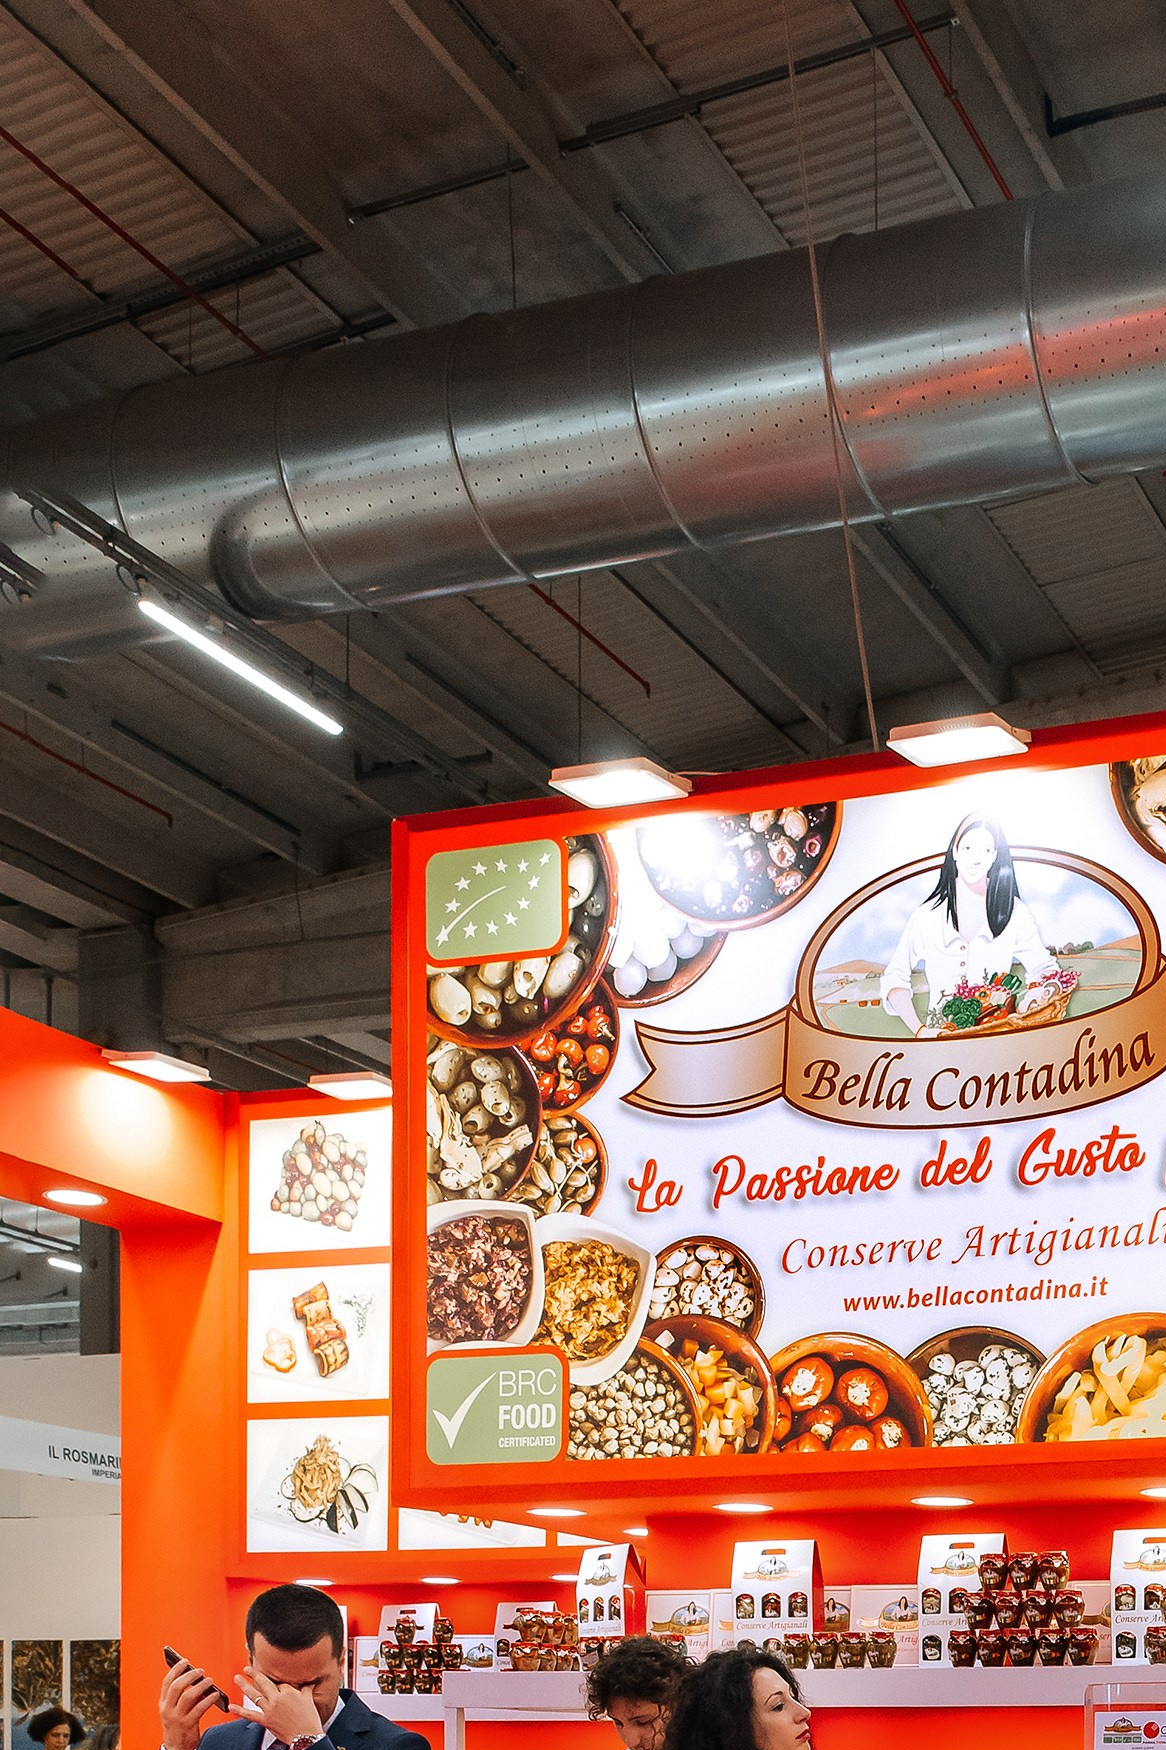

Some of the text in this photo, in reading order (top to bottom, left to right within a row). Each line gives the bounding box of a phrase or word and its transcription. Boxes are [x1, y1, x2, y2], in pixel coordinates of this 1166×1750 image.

[803, 1028, 1156, 1112] Bella Contadina
[628, 1158, 683, 1213] La
[711, 1154, 900, 1209] Passione
[921, 1136, 992, 1187] del
[1018, 1125, 1146, 1186] Gusto
[781, 1238, 942, 1275] Conserve
[844, 1276, 1108, 1312] www.bellacontadina.it
[499, 1368, 557, 1397] BRC
[498, 1403, 557, 1430] FOOD
[498, 1435, 556, 1449] CERTIFICATED
[48, 1445, 121, 1469] IL ROSMARI
[736, 1621, 767, 1631] Conserve
[1115, 1614, 1149, 1624] Conserve
